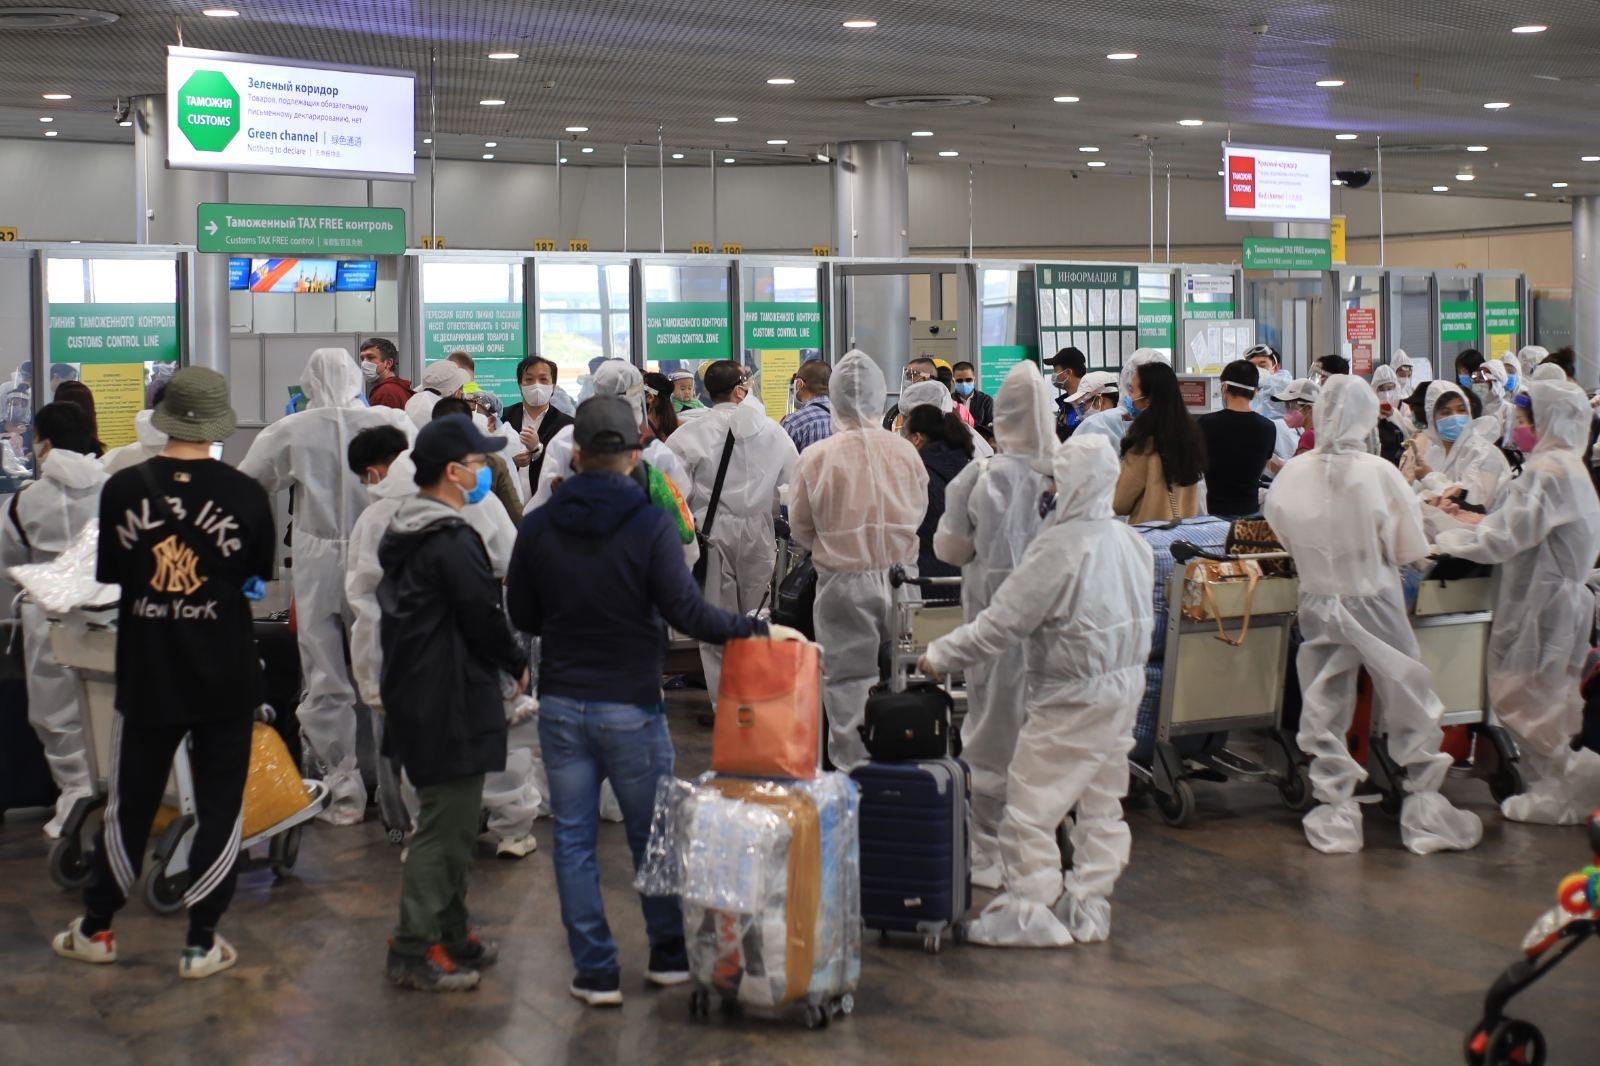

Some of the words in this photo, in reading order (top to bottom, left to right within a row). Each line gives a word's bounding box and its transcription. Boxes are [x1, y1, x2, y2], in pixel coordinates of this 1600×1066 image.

[248, 77, 293, 92] Зеленый
[296, 84, 339, 98] коридор
[186, 95, 232, 109] ТАМОЖНЯ
[321, 99, 369, 113] обязательному
[187, 114, 231, 127] CUSTOMS
[247, 128, 277, 139] Green
[280, 130, 318, 143] channel
[247, 144, 274, 154] Nothing
[275, 145, 282, 153] to
[283, 146, 306, 156] declare
[225, 216, 296, 229] Таможенный
[297, 217, 317, 229] TAX
[319, 218, 344, 230] FREE
[345, 220, 393, 232] контроль
[225, 235, 256, 245] Customs
[257, 236, 271, 245] TAX
[272, 236, 289, 245] FREE
[290, 236, 315, 246] control
[1058, 271, 1117, 285] ИНФОРМАЦИЯ
[49, 316, 76, 329] ЛИНИЯ
[78, 316, 135, 328] ТАМОЖЕННОГО
[138, 315, 176, 328] КОНТРОЛЯ
[647, 317, 662, 328] ЗОНА
[663, 317, 700, 328] ТАМОЖЕННОГО
[701, 317, 728, 328] КОНТРОЛЯ
[760, 312, 795, 322] ТАМОЖЕННОГО
[447, 322, 493, 330] ОТВЕТСТВЕННОСТЬ
[656, 333, 681, 344] CUSTOMS
[682, 333, 705, 344] CONTROL
[705, 333, 719, 344] ZONE
[752, 328, 775, 338] CUSTOMS
[777, 328, 798, 338] CONTROL
[800, 328, 810, 337] LINE
[67, 335, 103, 348] CUSTOMS
[106, 335, 140, 348] CONTROL
[143, 335, 160, 347] LINE
[132, 596, 169, 618] New
